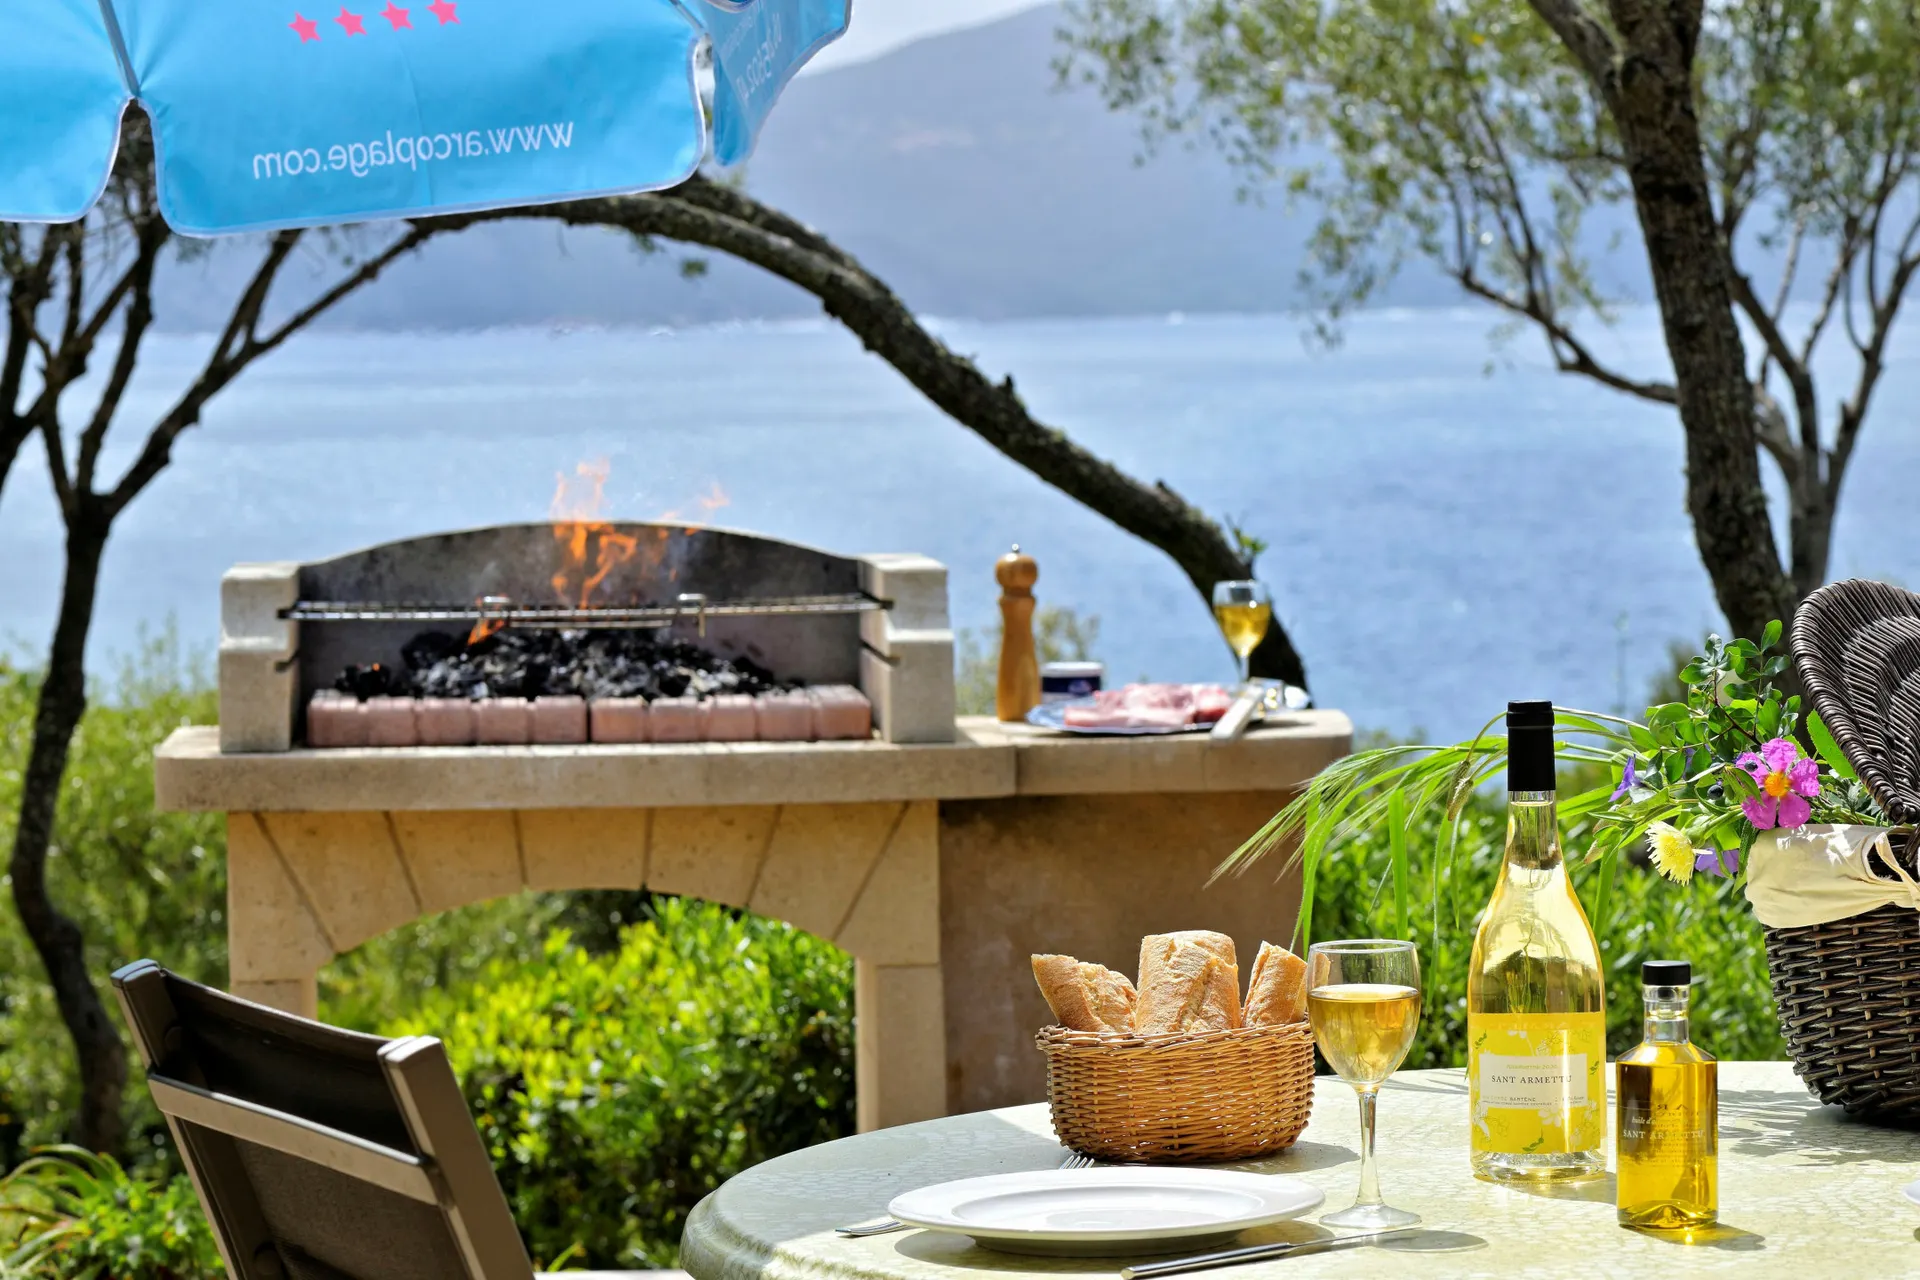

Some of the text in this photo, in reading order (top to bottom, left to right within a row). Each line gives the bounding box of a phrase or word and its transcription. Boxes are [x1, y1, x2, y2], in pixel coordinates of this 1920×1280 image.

[1491, 1075, 1572, 1084] SANT ARMETTU
[1623, 1129, 1705, 1140] SANT ARTTU
